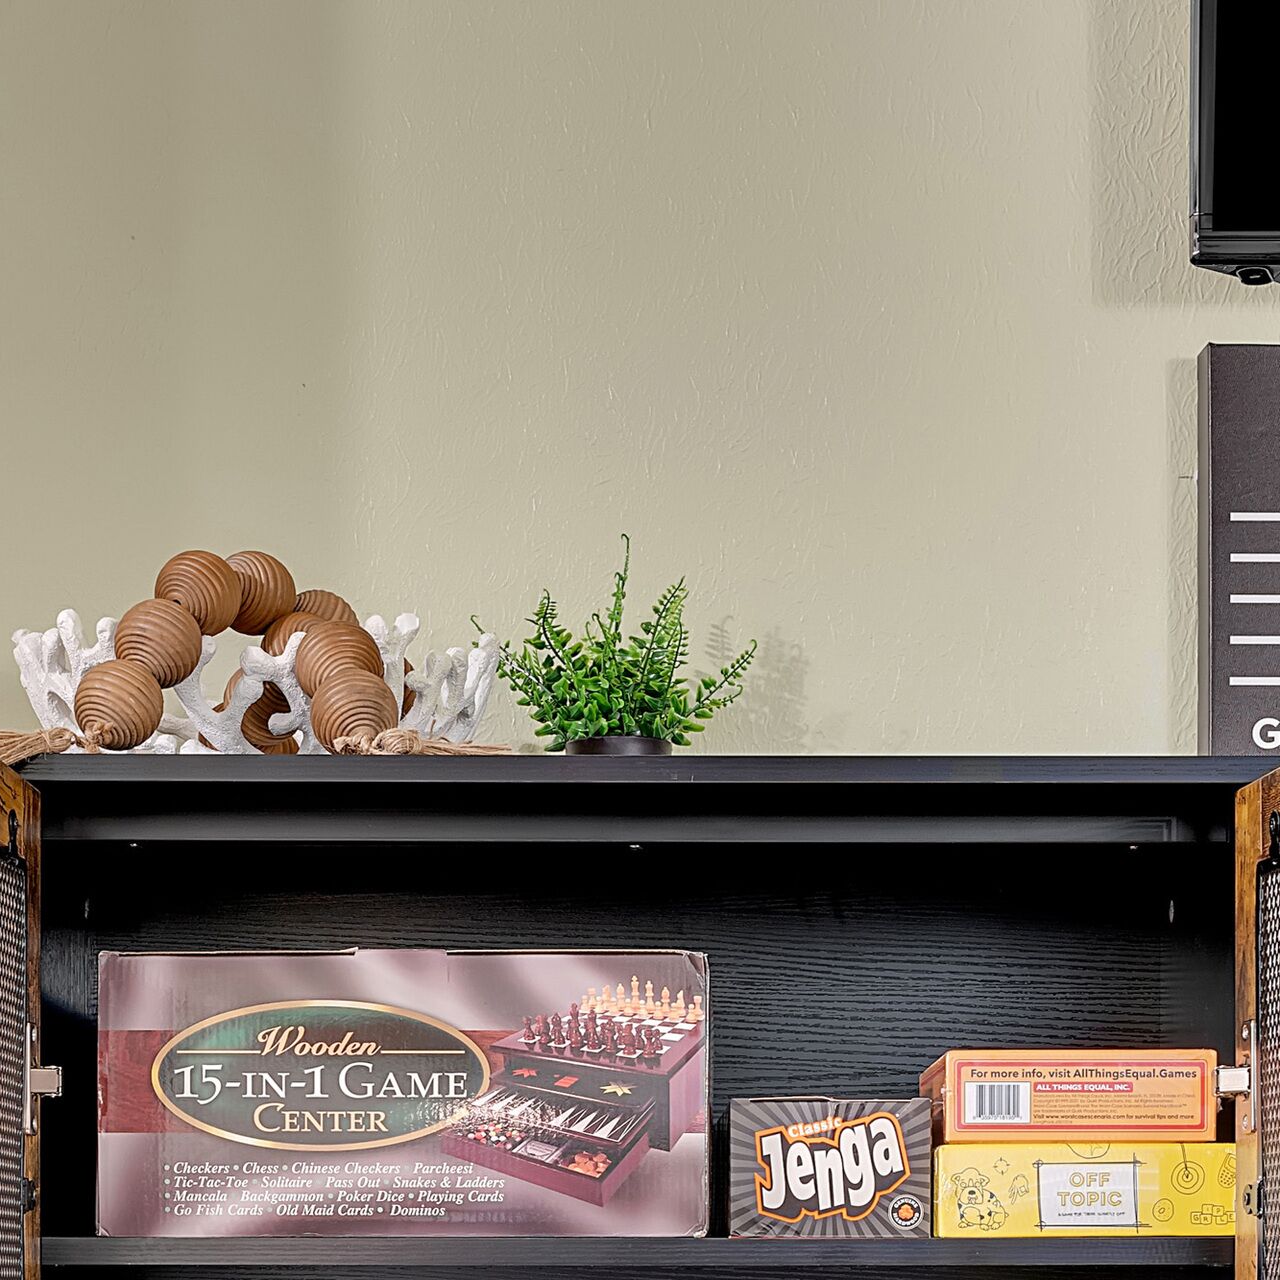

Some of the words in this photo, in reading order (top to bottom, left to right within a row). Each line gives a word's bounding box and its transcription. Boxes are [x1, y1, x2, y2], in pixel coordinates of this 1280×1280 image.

[257, 1025, 382, 1057] Wooden
[971, 1069, 988, 1078] For
[990, 1070, 1019, 1078] more
[1022, 1069, 1046, 1079] info,
[1048, 1069, 1071, 1078] visit
[1073, 1068, 1197, 1081] AllThingsEqual.Games
[173, 1063, 330, 1106] 15-IN-1
[1036, 1083, 1051, 1091] ALL
[1052, 1083, 1082, 1091] THINGS
[1084, 1083, 1113, 1092] EQUAL,
[1114, 1083, 1131, 1091] INC.
[253, 1101, 389, 1132] CENTER
[787, 1116, 843, 1138] Classic
[173, 1162, 230, 1174] Checkers
[242, 1162, 279, 1174] Chess
[291, 1162, 340, 1174] Chinese
[344, 1162, 401, 1174] Checkers
[413, 1162, 474, 1174] Parcheesi
[761, 1117, 904, 1211] Jenga
[173, 1176, 249, 1188] Tic-Tac-Toe
[261, 1176, 312, 1188] Solitaire
[325, 1176, 354, 1188] Pass
[357, 1176, 380, 1188] Out
[393, 1176, 437, 1188] Snakes
[440, 1176, 451, 1188] &
[455, 1176, 505, 1188] Ladders
[1069, 1172, 1111, 1188] OFF
[173, 1190, 228, 1202] Mancala
[240, 1190, 324, 1204] Backgammon
[337, 1190, 374, 1202] Poker
[376, 1190, 405, 1202] Dice
[417, 1190, 464, 1205] Playing
[467, 1190, 505, 1202] Cards
[1057, 1191, 1122, 1207] TOPIC
[173, 1204, 192, 1216] Go
[196, 1204, 223, 1216] Fish
[227, 1204, 264, 1216] Cards
[276, 1204, 299, 1216] Old
[301, 1204, 334, 1216] Maid
[337, 1204, 374, 1216] Cards
[389, 1204, 446, 1216] Dominos
